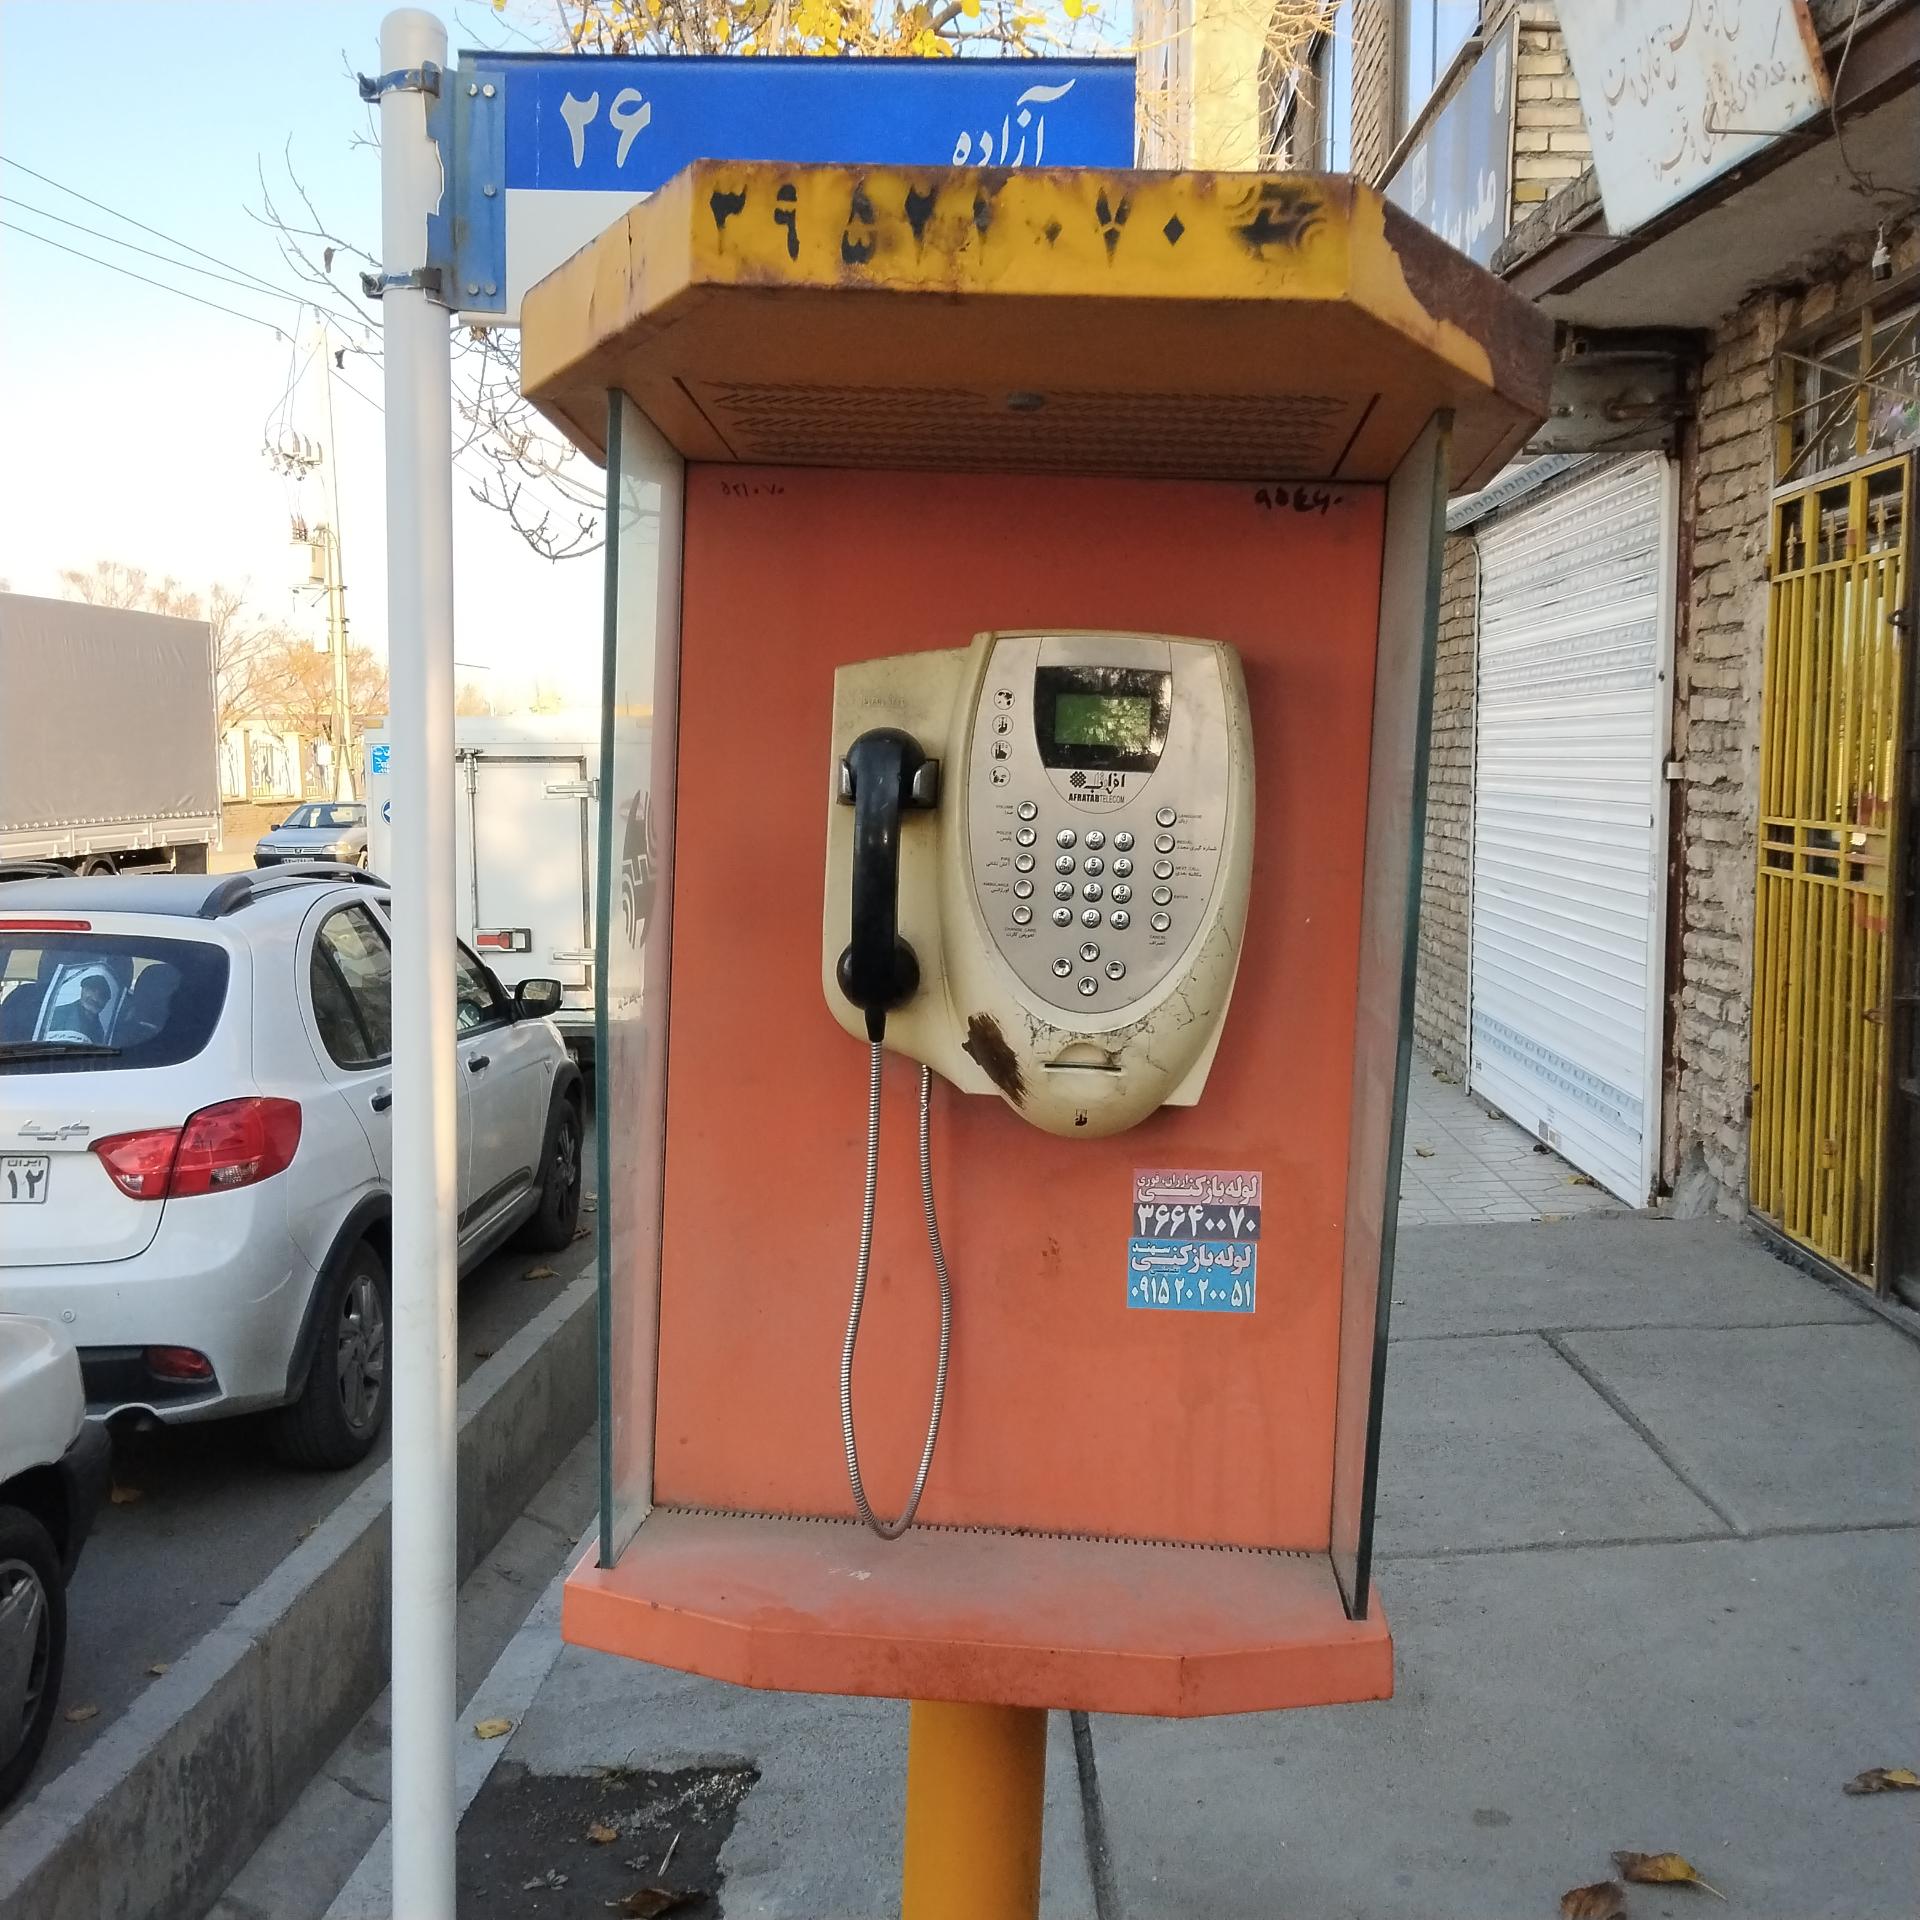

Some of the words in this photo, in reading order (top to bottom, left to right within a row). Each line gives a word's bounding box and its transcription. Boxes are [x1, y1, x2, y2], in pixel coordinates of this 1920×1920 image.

[559, 87, 651, 169] ۲۶
[953, 78, 1075, 167] آزاده
[8, 1170, 44, 1199] ۱۲
[1225, 1175, 1257, 1205] لوله
[1137, 1204, 1256, 1239] ۳۶۶۴۰۰۷۰
[1214, 1244, 1252, 1275] لوله
